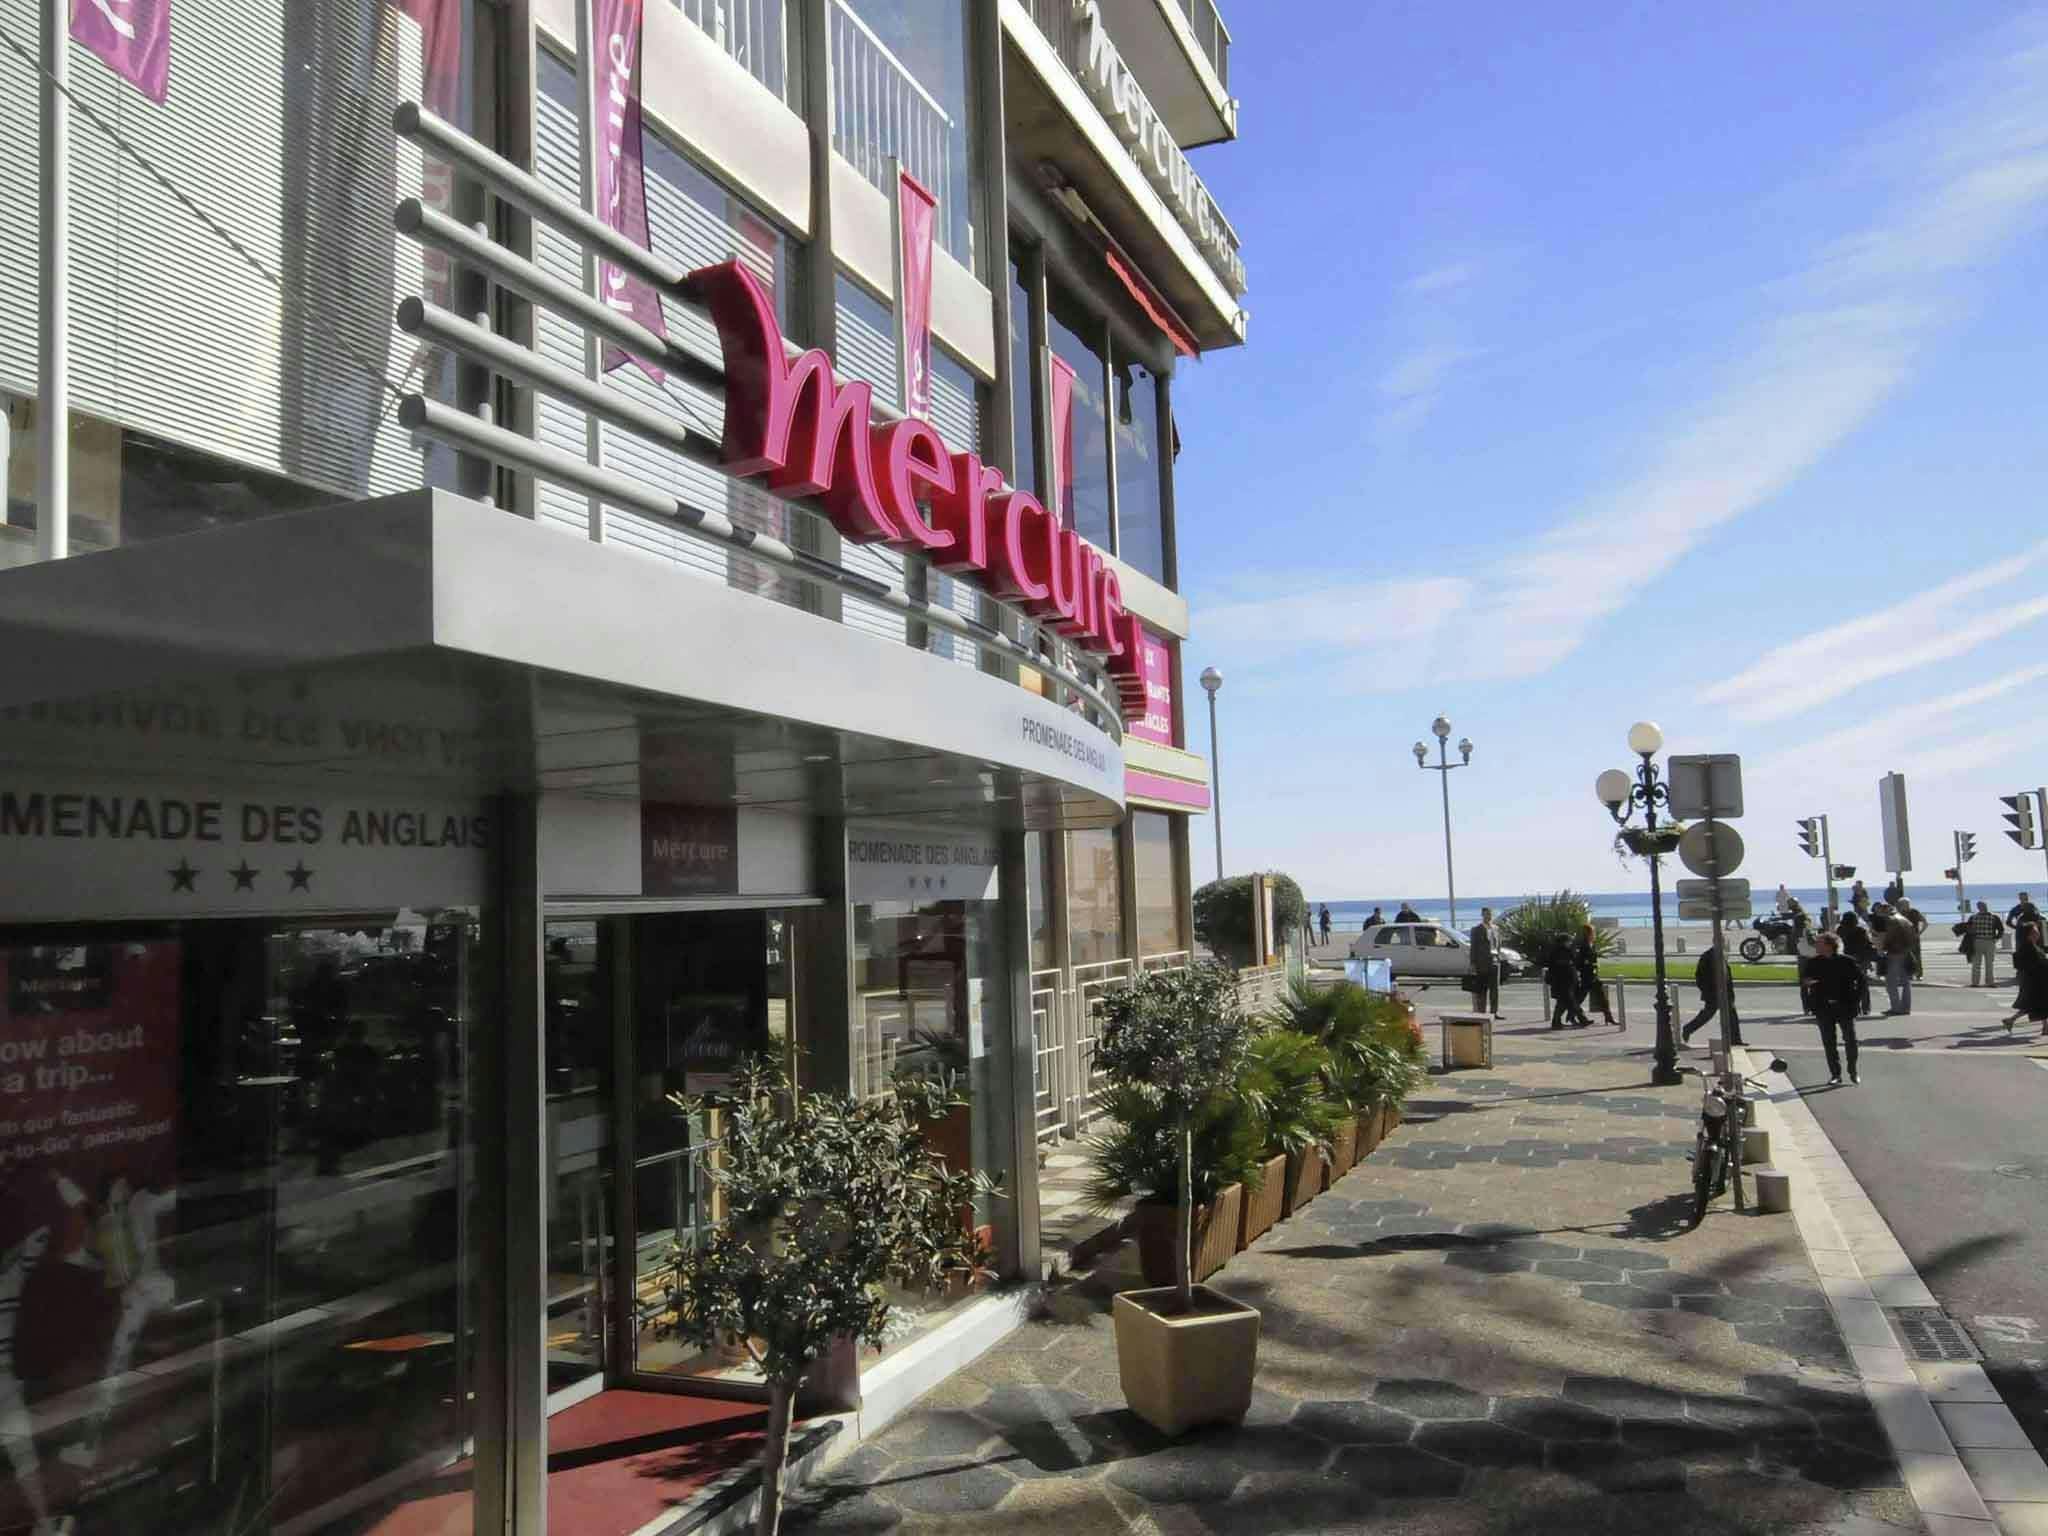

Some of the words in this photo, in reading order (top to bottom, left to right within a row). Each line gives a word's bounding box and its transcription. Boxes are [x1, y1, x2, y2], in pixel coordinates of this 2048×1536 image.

[242, 803, 322, 845] DES
[340, 809, 491, 850] ANGLAIS
[925, 844, 949, 866] DES
[57, 1023, 144, 1056] about
